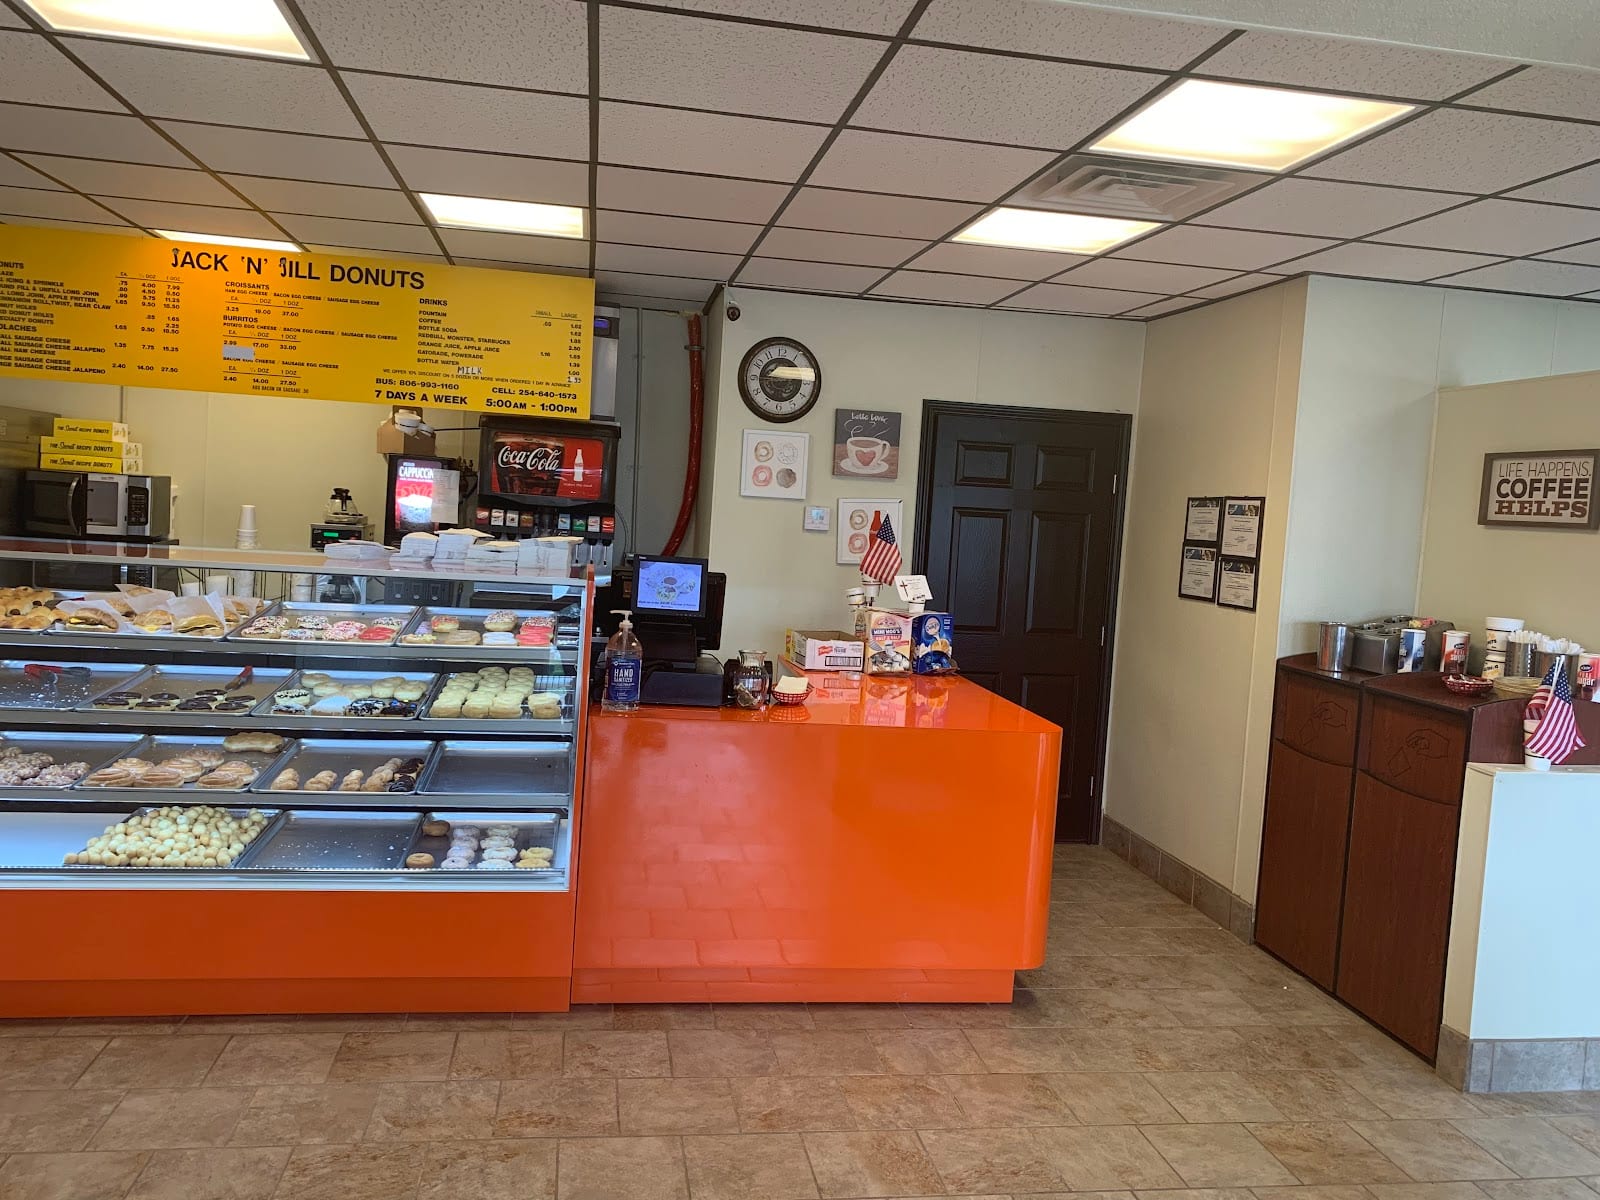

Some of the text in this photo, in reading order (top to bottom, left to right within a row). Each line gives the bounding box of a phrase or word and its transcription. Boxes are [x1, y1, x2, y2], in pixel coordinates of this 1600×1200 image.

[171, 247, 229, 272] JACK
[279, 256, 320, 280] JILL
[330, 264, 425, 290] DONUTS
[225, 281, 270, 290] CROISSANTS
[419, 298, 448, 306] DRINKS
[223, 314, 259, 323] BURRITOS
[478, 337, 511, 345] STARBUCKS
[457, 366, 482, 375] MILK
[375, 377, 459, 390] BUS: 806-993-1160
[374, 390, 468, 405] 7 DAYS A WEEK
[492, 387, 577, 400] CELL: 254-640-1573
[485, 398, 577, 413] 5:00AM 1:00PM
[1499, 461, 1591, 478] LIFE HAPPENS.
[1496, 477, 1590, 499] COFFEE
[1494, 500, 1588, 518] HELPS
[614, 668, 634, 677] HAND
